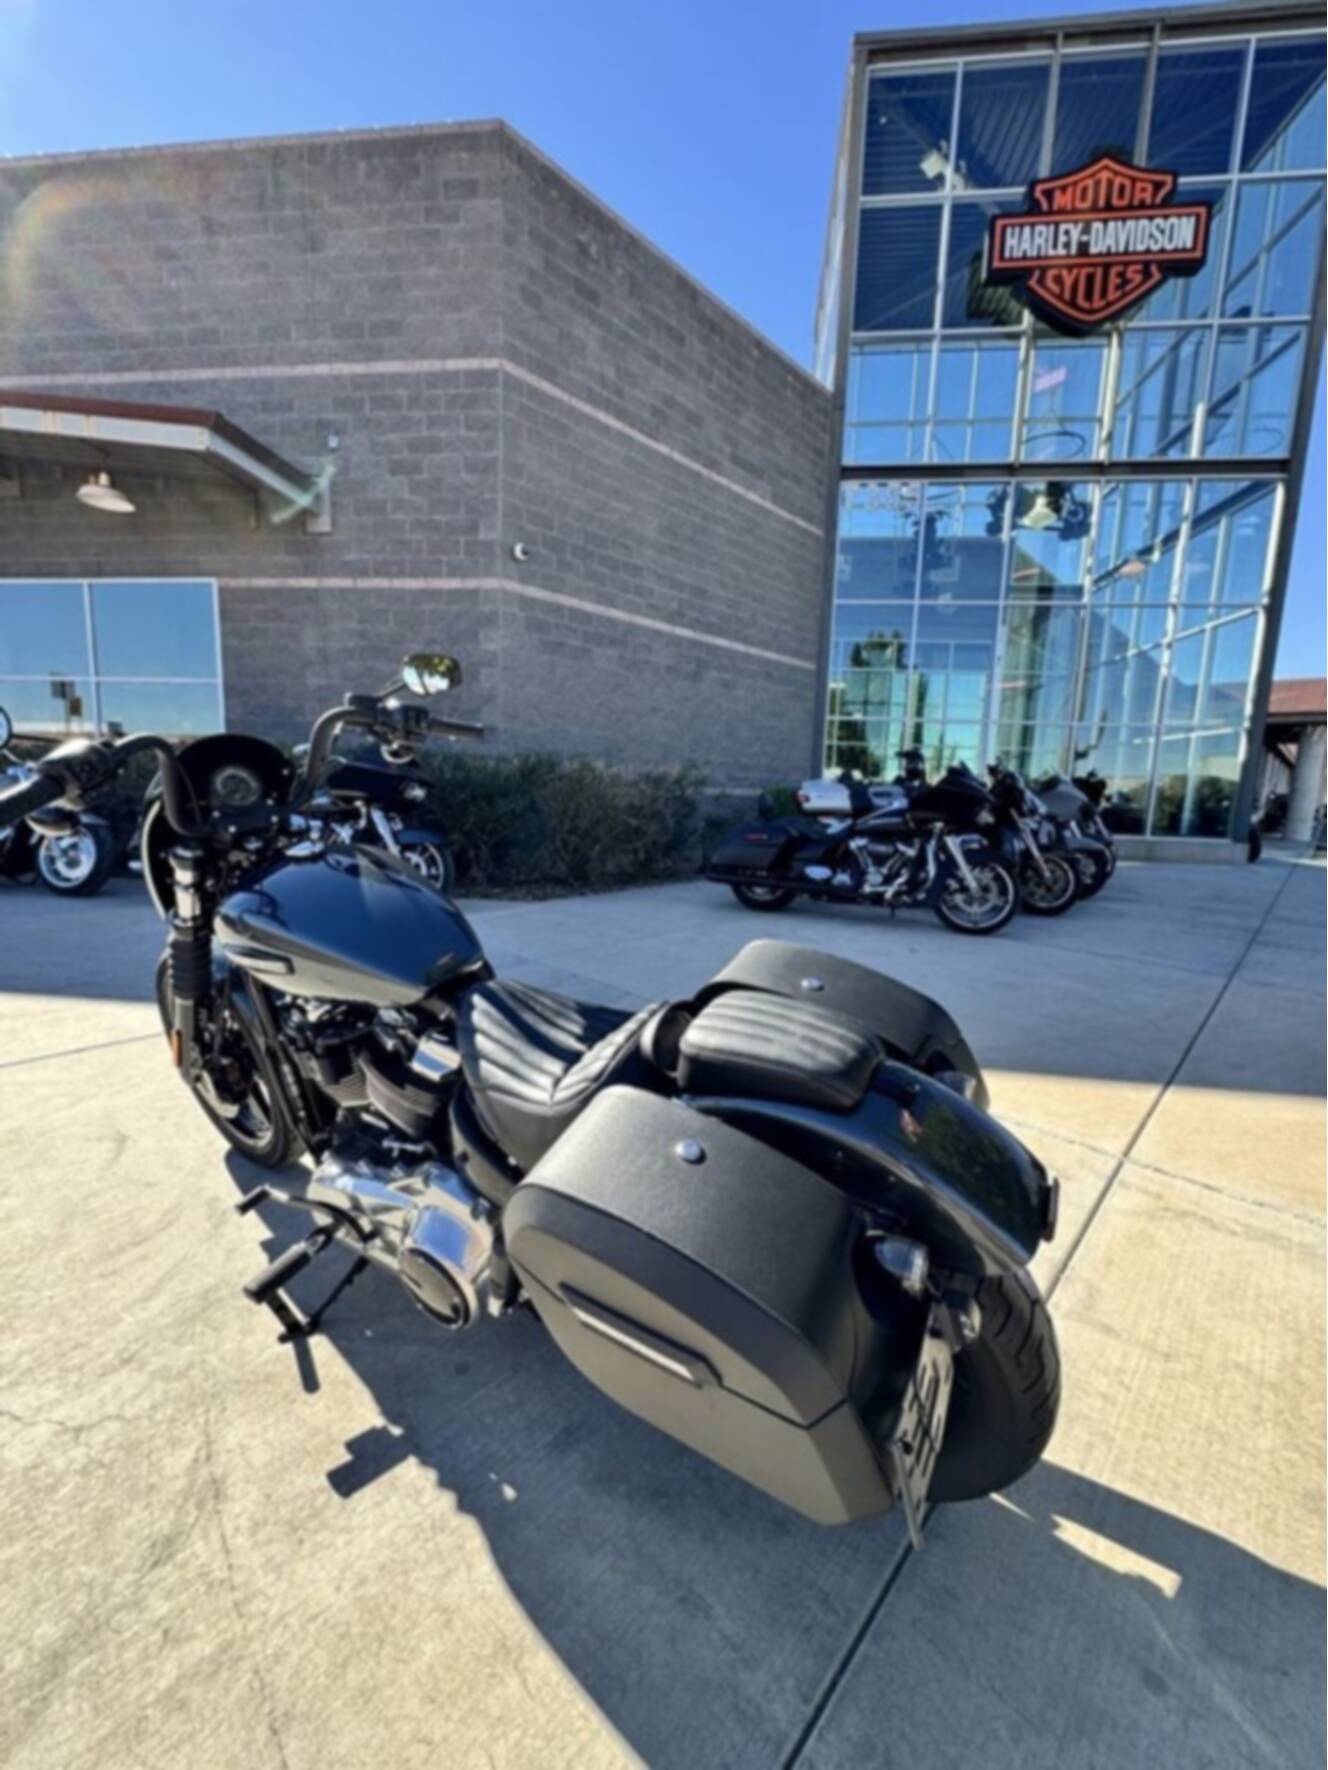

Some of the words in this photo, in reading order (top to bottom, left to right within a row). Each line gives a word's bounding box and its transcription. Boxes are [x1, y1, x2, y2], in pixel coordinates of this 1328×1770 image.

[1053, 171, 1154, 210] MOTOR
[1003, 215, 1196, 259] HARLEY-DAVIDSON
[1045, 265, 1143, 309] CYCLES
